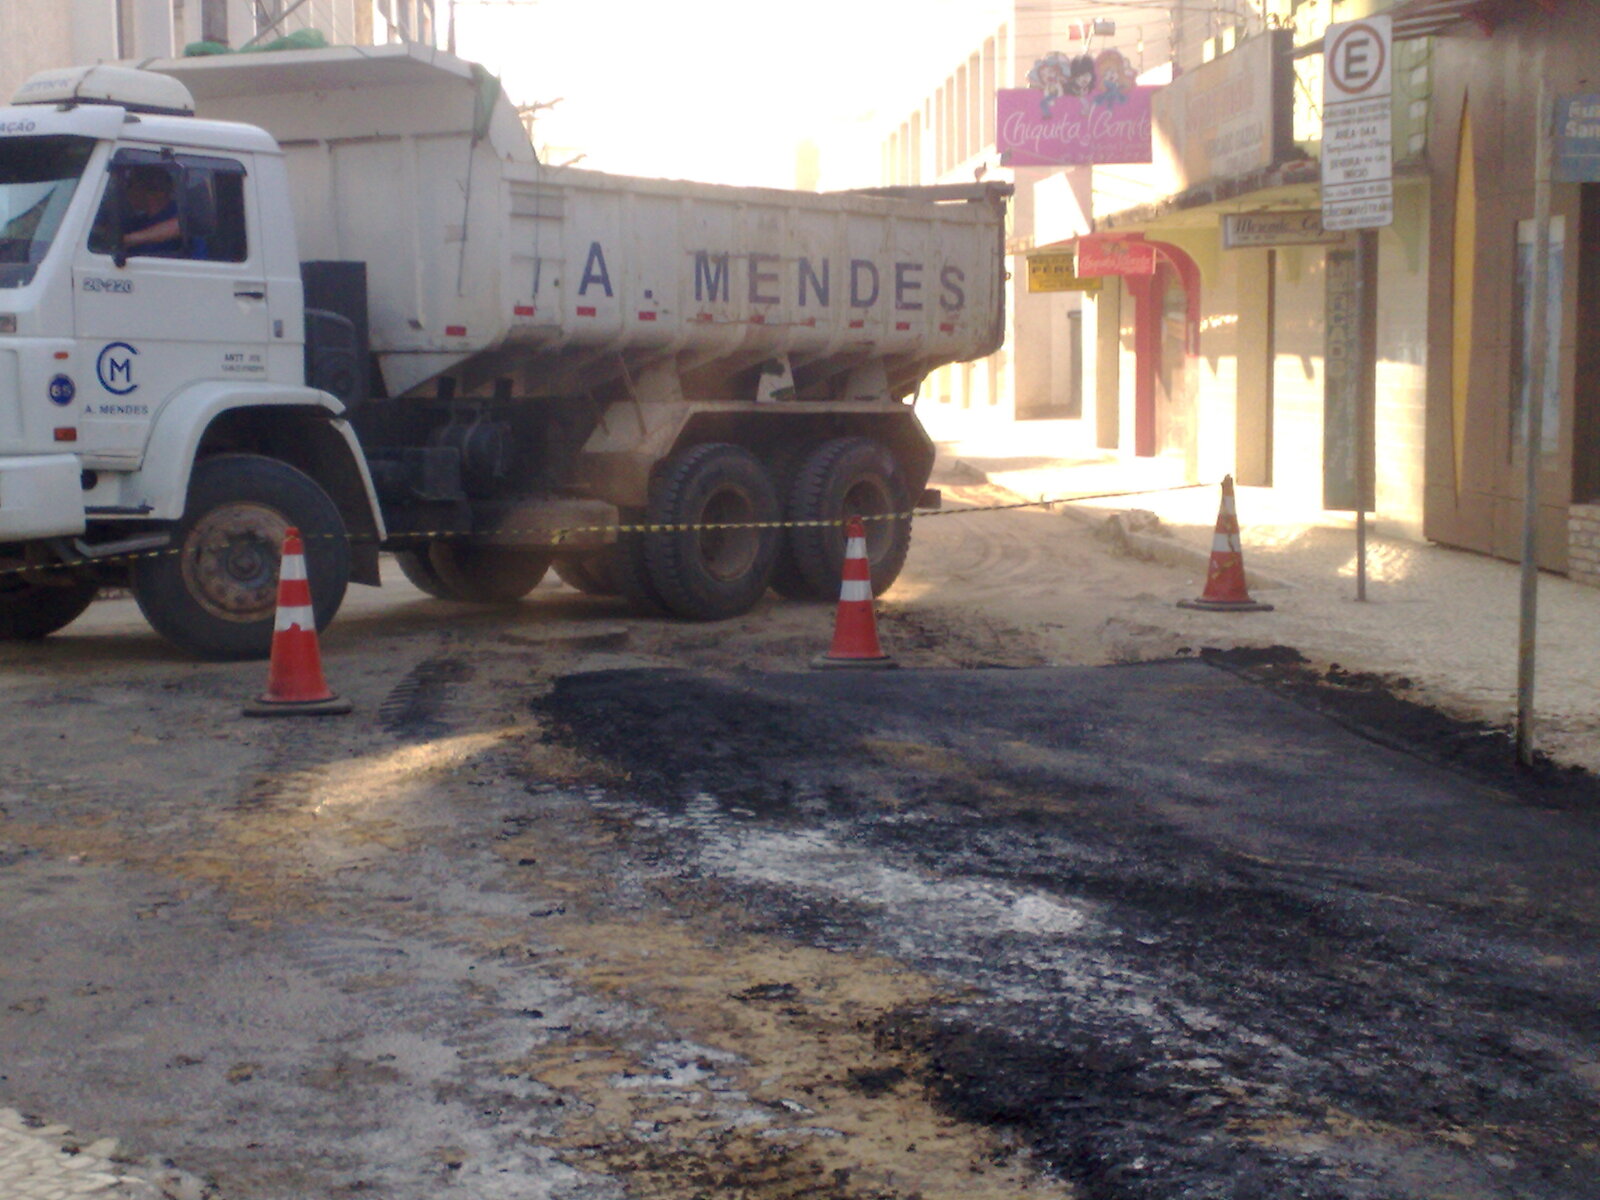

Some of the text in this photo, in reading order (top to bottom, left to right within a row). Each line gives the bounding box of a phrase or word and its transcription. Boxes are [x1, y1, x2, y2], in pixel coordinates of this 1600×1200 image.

[1343, 37, 1370, 81] E
[694, 250, 966, 314] MENDES
[99, 404, 149, 416] MENDES
